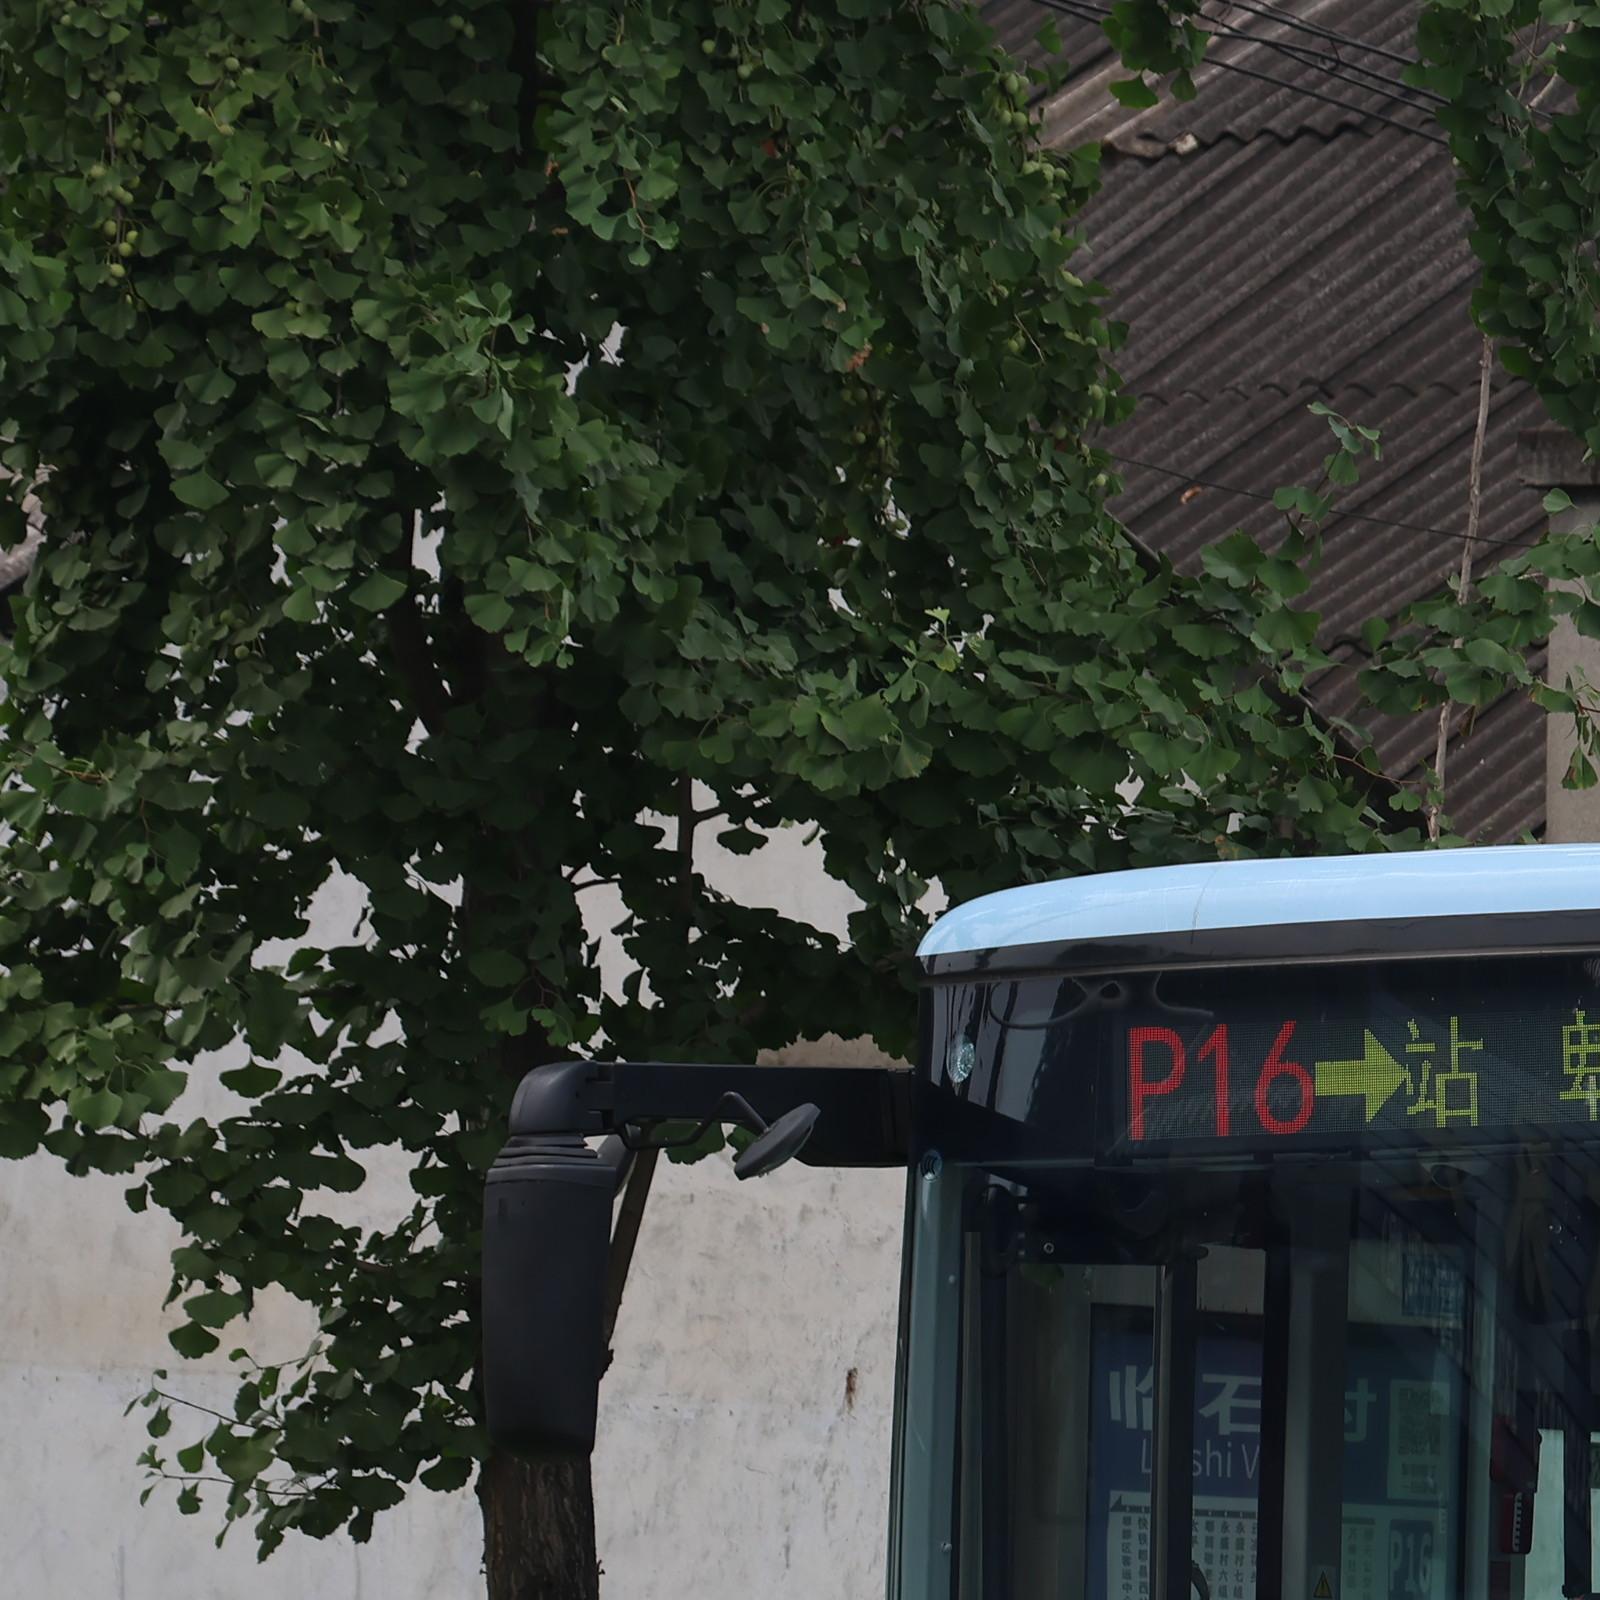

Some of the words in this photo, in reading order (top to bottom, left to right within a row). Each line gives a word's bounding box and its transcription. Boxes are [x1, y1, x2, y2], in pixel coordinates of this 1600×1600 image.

[1128, 1020, 1314, 1140] P16
[1404, 1016, 1483, 1127] 站
[1389, 1529, 1433, 1593] P16
